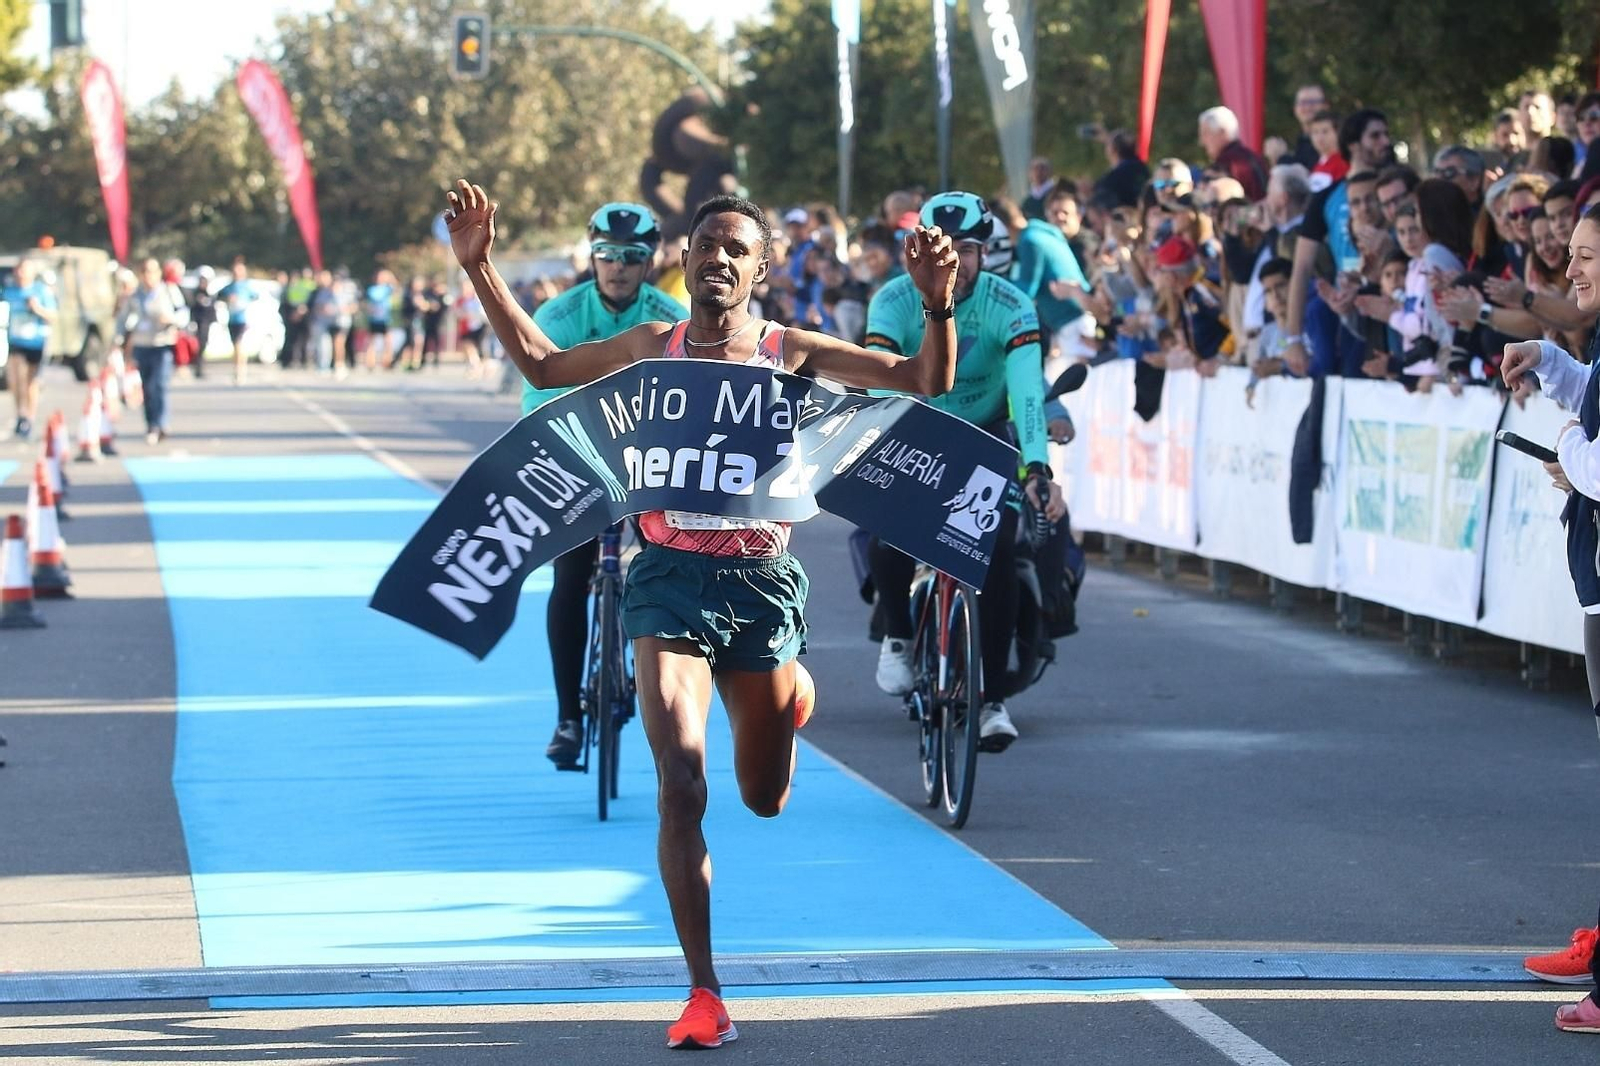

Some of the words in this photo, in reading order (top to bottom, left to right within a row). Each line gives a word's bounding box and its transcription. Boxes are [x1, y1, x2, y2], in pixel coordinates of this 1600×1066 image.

[857, 463, 895, 489] CIUDAD
[873, 438, 947, 490] ALMERÍA
[431, 529, 469, 566] GRUPO
